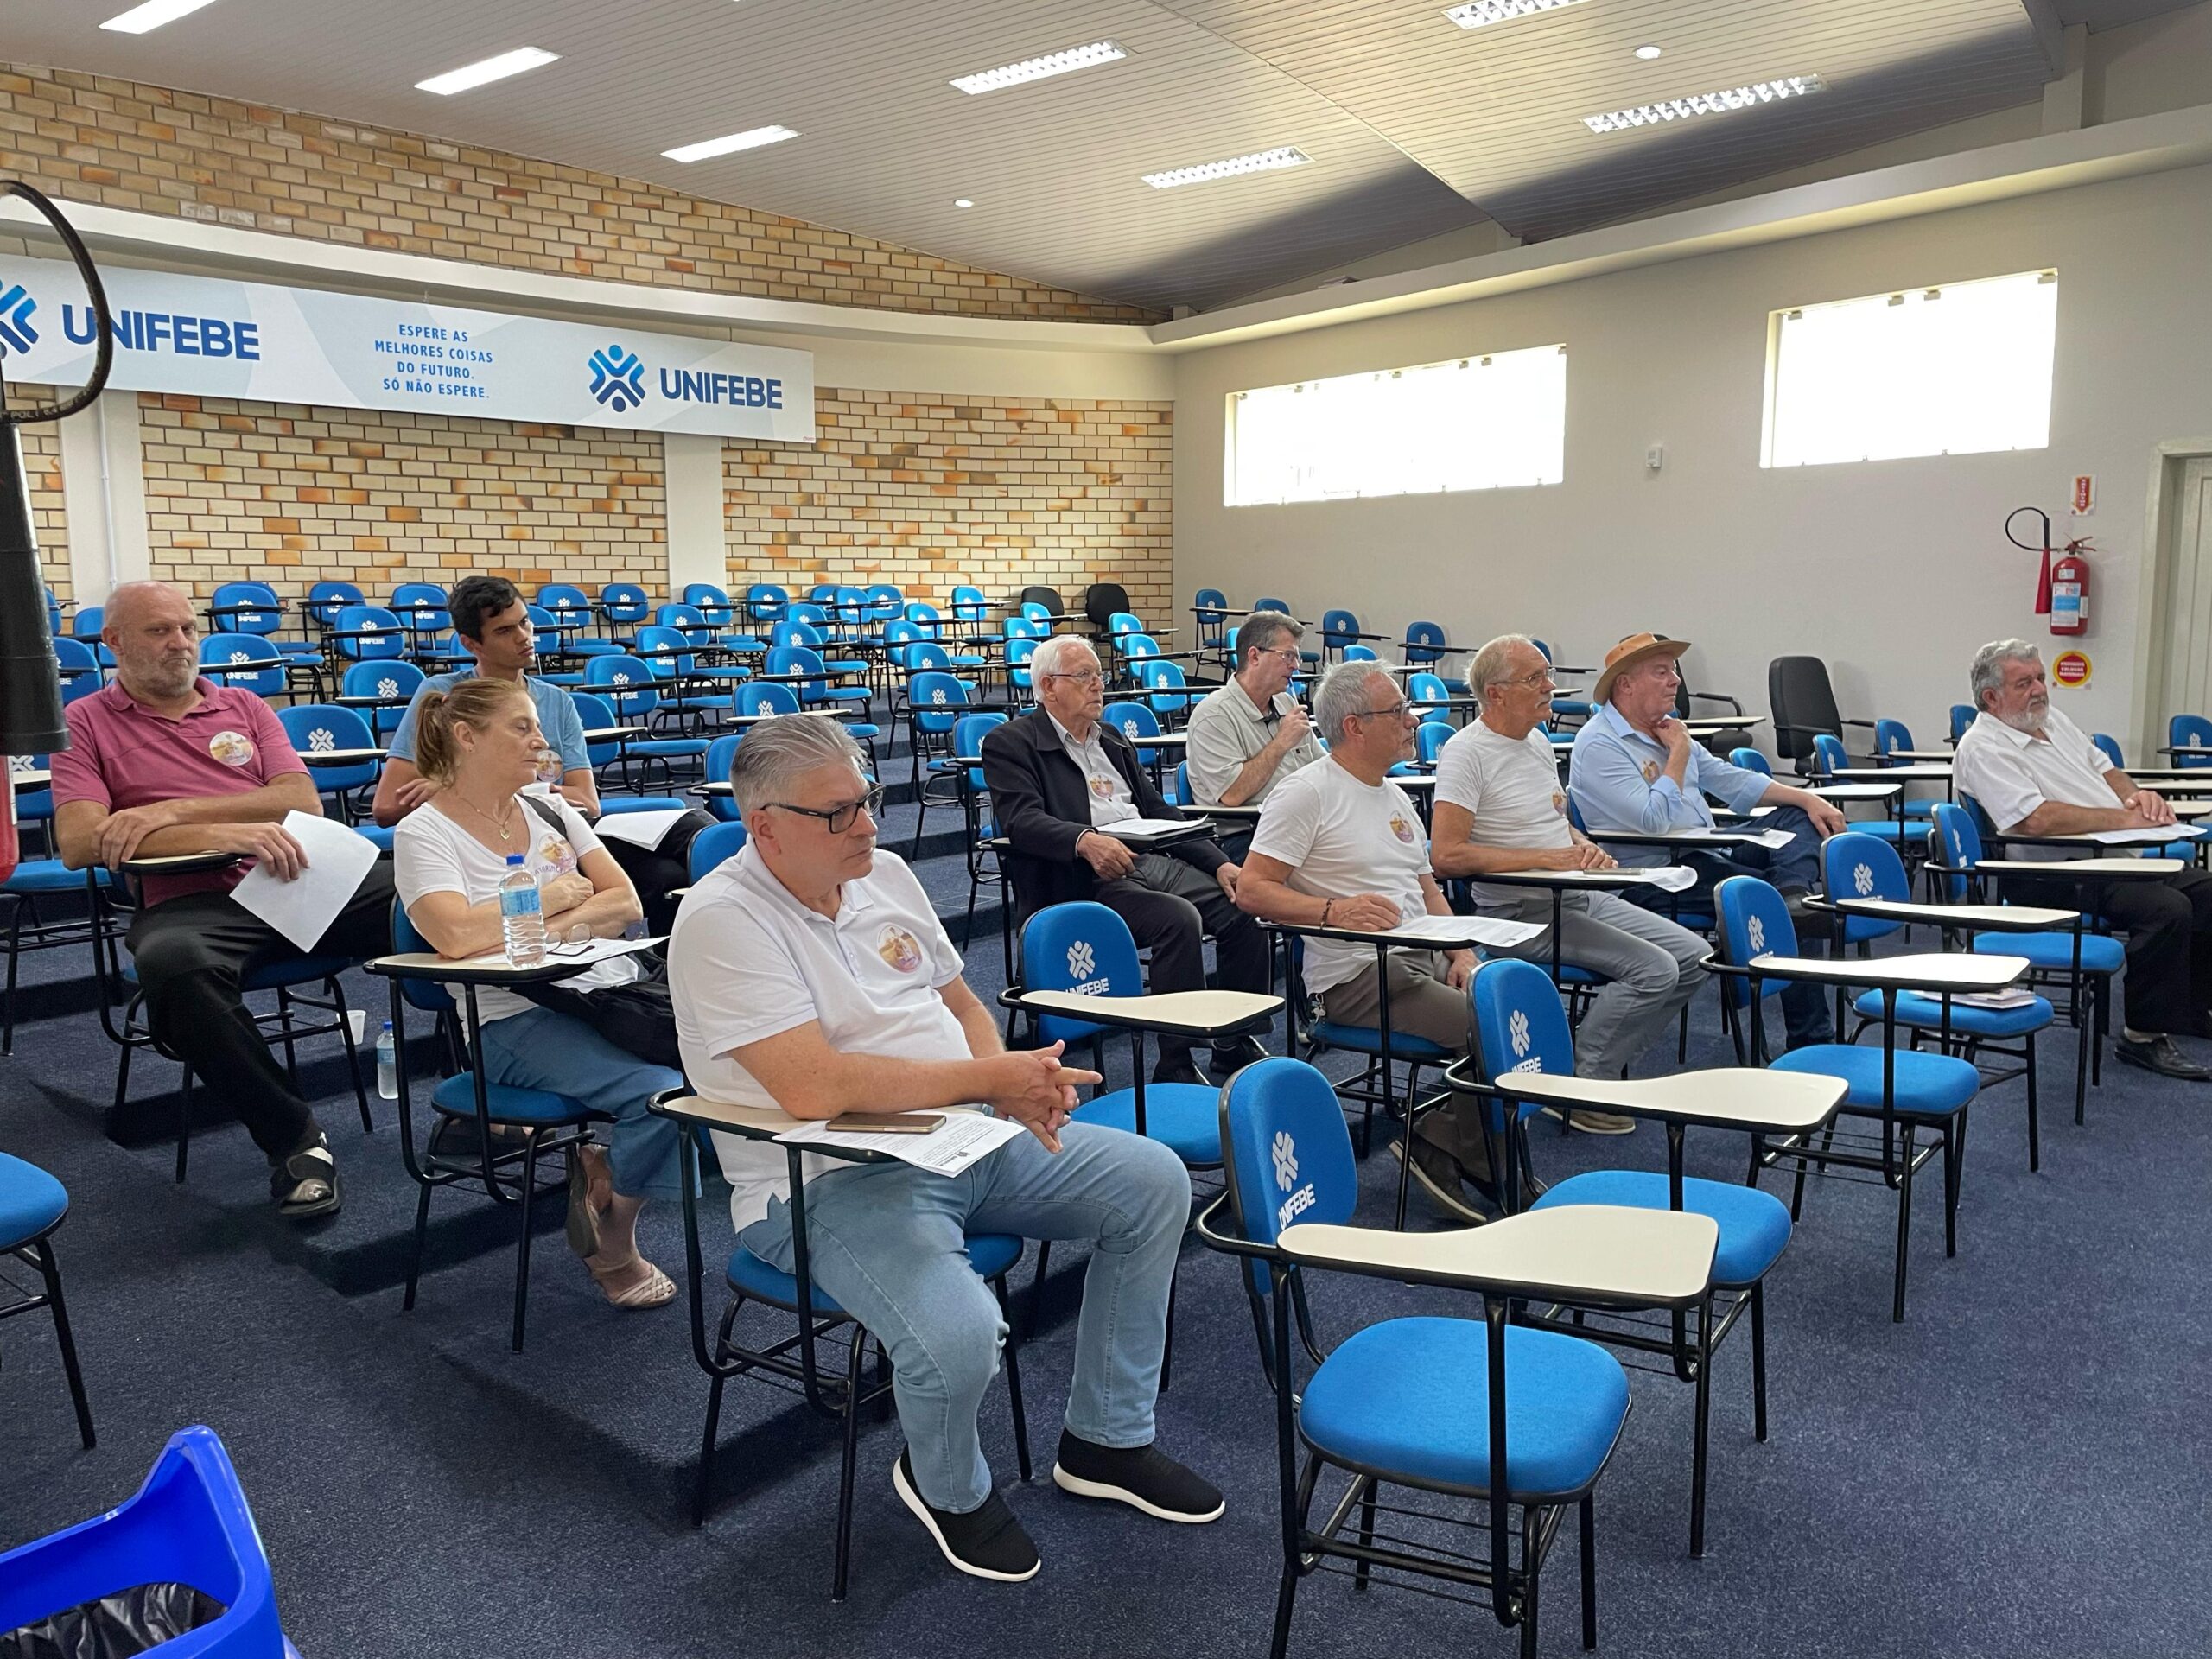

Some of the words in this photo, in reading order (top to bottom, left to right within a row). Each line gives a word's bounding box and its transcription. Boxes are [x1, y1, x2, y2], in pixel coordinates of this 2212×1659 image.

[62, 304, 260, 361] UNIFEBE
[398, 324, 448, 340] ESPERE
[453, 330, 468, 342] AS
[374, 340, 443, 358] MELHORES
[449, 348, 493, 363] COISAS
[397, 361, 415, 373] DO
[421, 363, 474, 379] FUTURO.
[383, 377, 400, 391] SÓ
[406, 378, 432, 393] NÃO
[438, 384, 490, 398] ESPERE.
[659, 367, 783, 410] UNIFEBE
